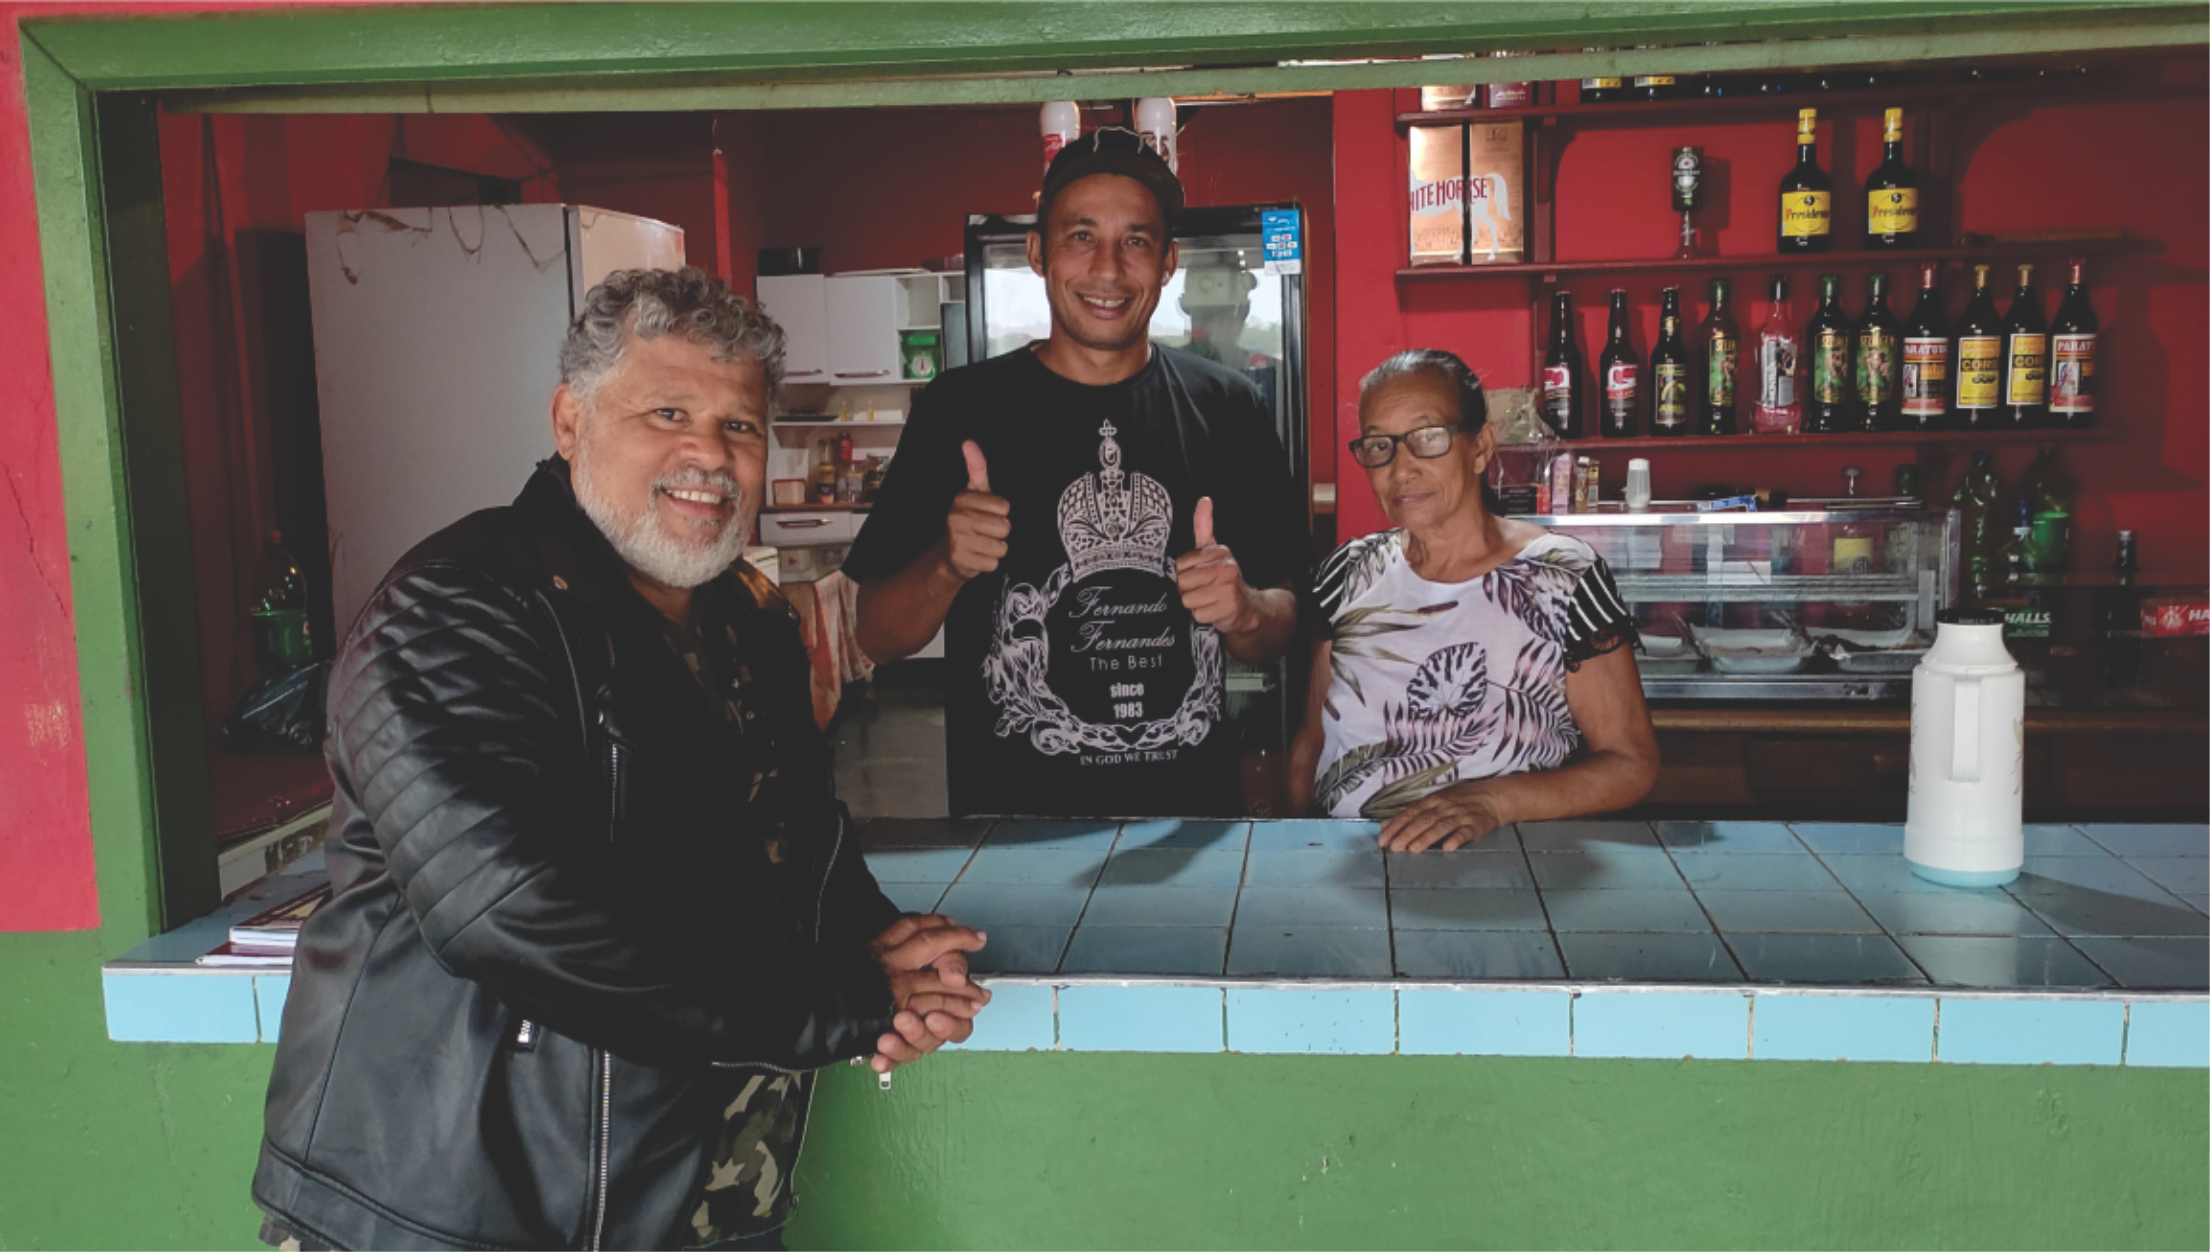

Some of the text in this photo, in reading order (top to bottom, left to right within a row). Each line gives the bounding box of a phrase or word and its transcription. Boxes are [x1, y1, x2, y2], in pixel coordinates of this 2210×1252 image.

[2057, 340, 2096, 352] PARAT
[1069, 586, 1168, 618] Fernando
[2004, 611, 2053, 624] HALLS
[1071, 620, 1176, 652] Fernandes
[1090, 654, 1163, 672] The Best
[1110, 682, 1145, 699] since
[1113, 702, 1144, 719] 1983
[1080, 749, 1179, 766] IN GOD WE TRUST
